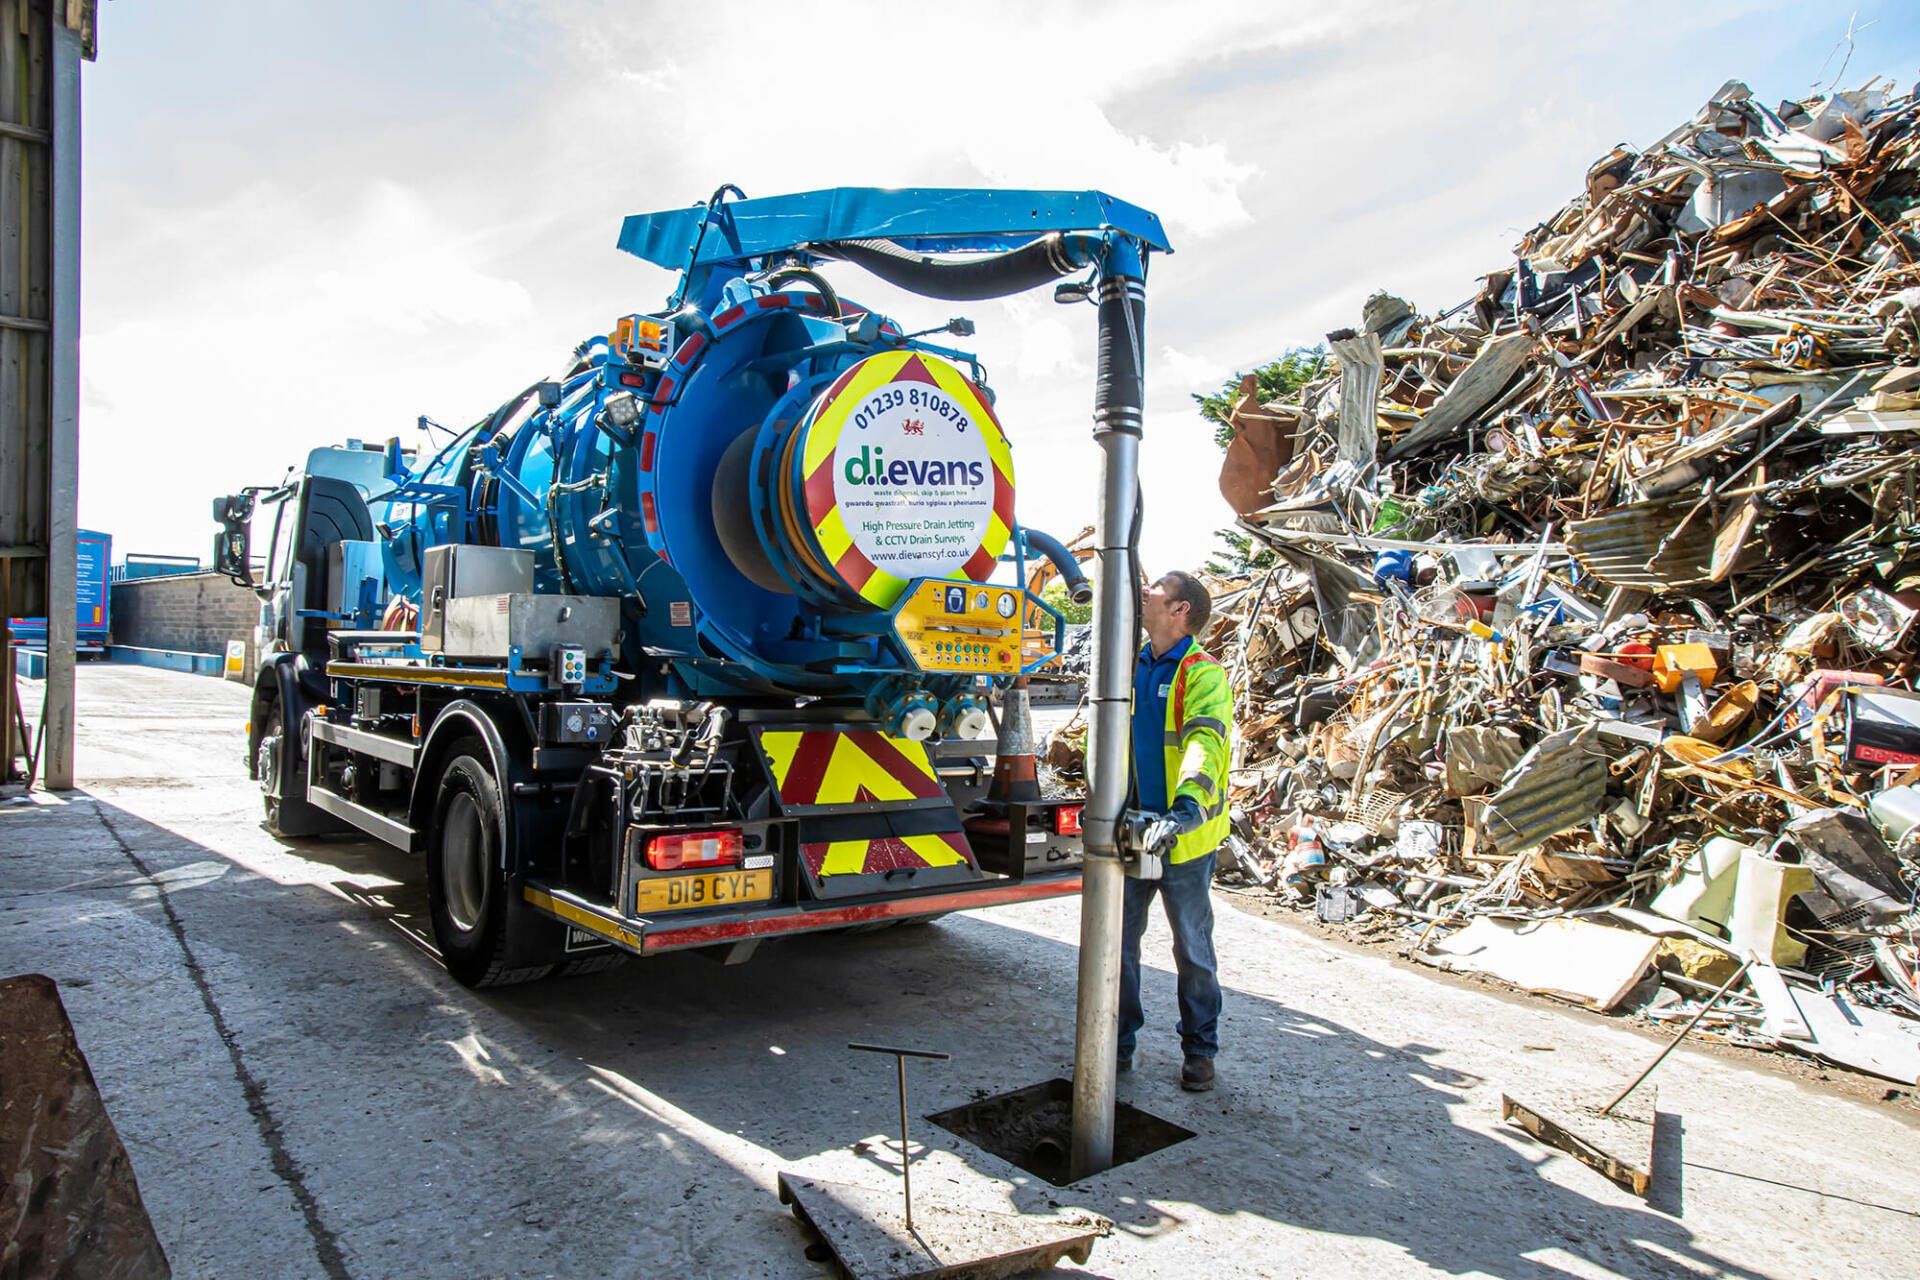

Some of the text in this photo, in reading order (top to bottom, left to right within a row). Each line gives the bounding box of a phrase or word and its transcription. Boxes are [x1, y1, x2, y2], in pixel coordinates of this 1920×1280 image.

[854, 388, 969, 433] 01239 810878
[845, 500, 874, 508] gwaredu
[862, 519, 975, 533] High Pressure Drain Jetting
[875, 535, 965, 546] & CCTV Drain Surveys
[871, 548, 970, 561] www.dievanscyf.co.uk
[712, 873, 757, 900] CYF
